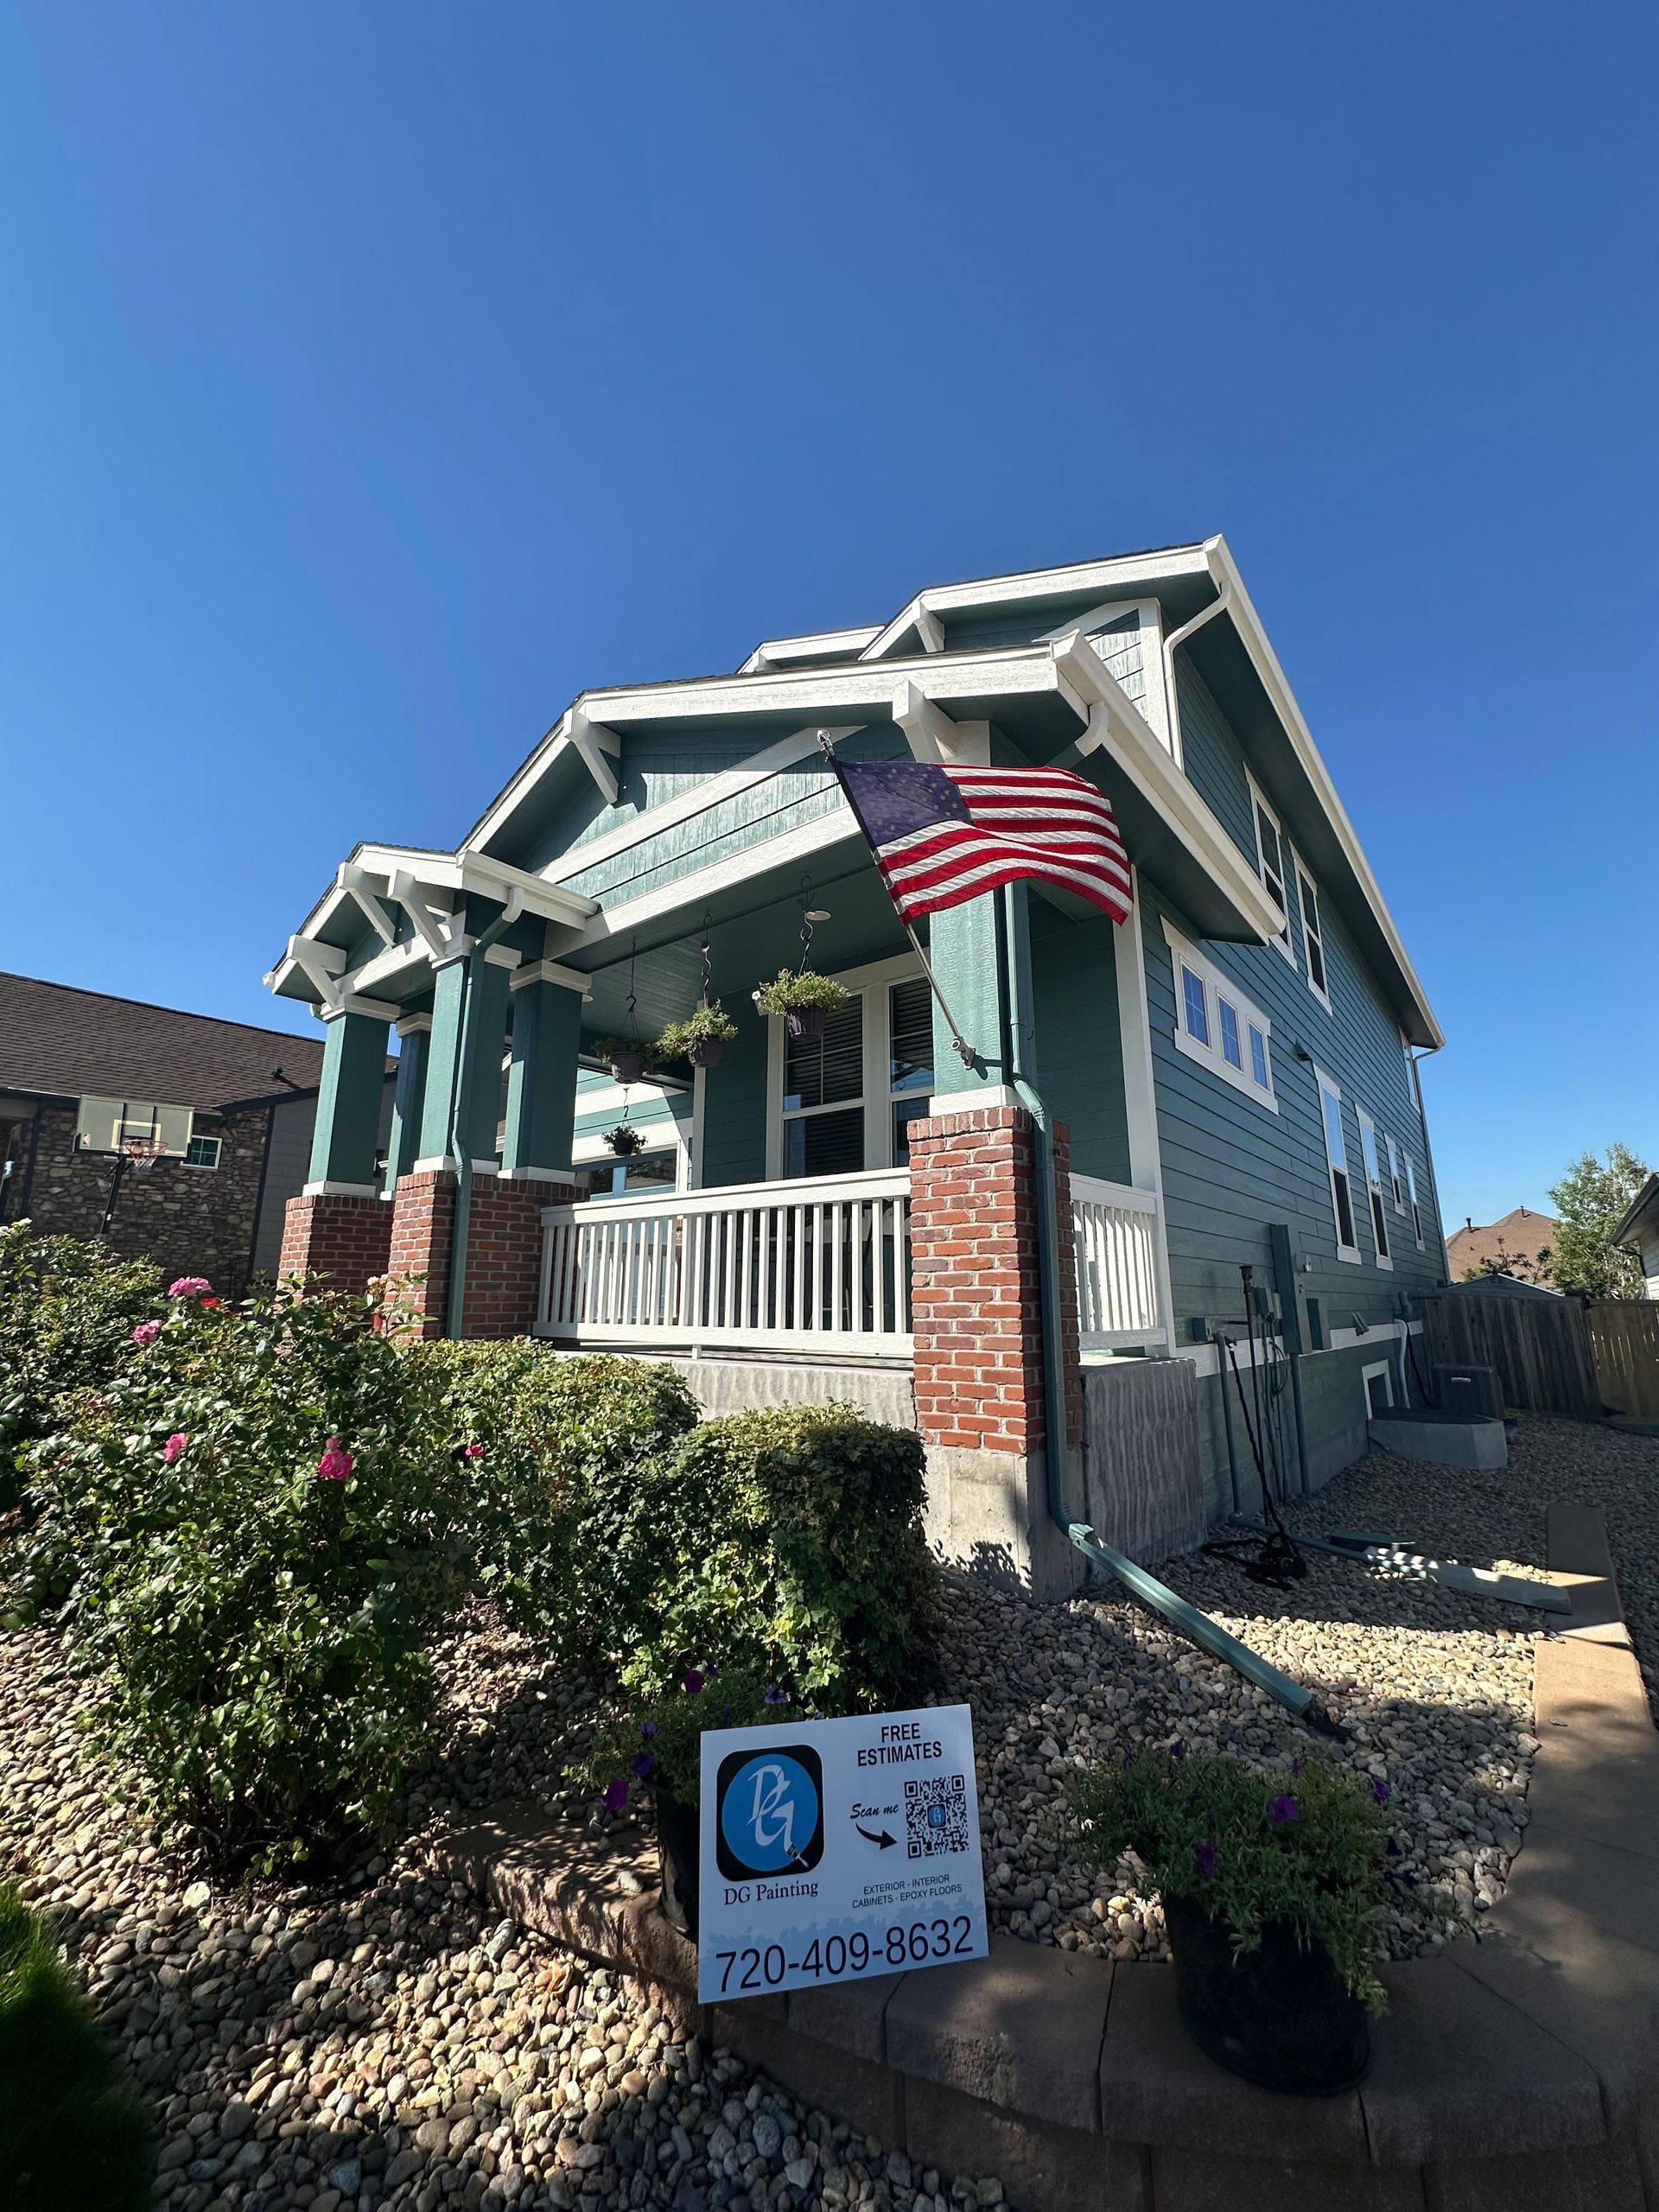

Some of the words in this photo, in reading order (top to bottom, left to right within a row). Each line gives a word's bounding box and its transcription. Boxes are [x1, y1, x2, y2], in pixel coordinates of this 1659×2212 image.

[881, 1722, 921, 1744] FREE
[857, 1741, 943, 1767] ESTIMATES
[850, 1802, 880, 1819] Scan
[883, 1803, 899, 1815] me
[724, 1885, 751, 1906] DG
[756, 1880, 819, 1902] Painting
[852, 1894, 893, 1909] CABINETS
[899, 1890, 928, 1902] EPOXY
[930, 1883, 963, 1897] FLOORS
[863, 1880, 906, 1895] EXTERIOR
[912, 1873, 950, 1888] INTERIOR
[715, 1915, 974, 1993] 720-409-8632
